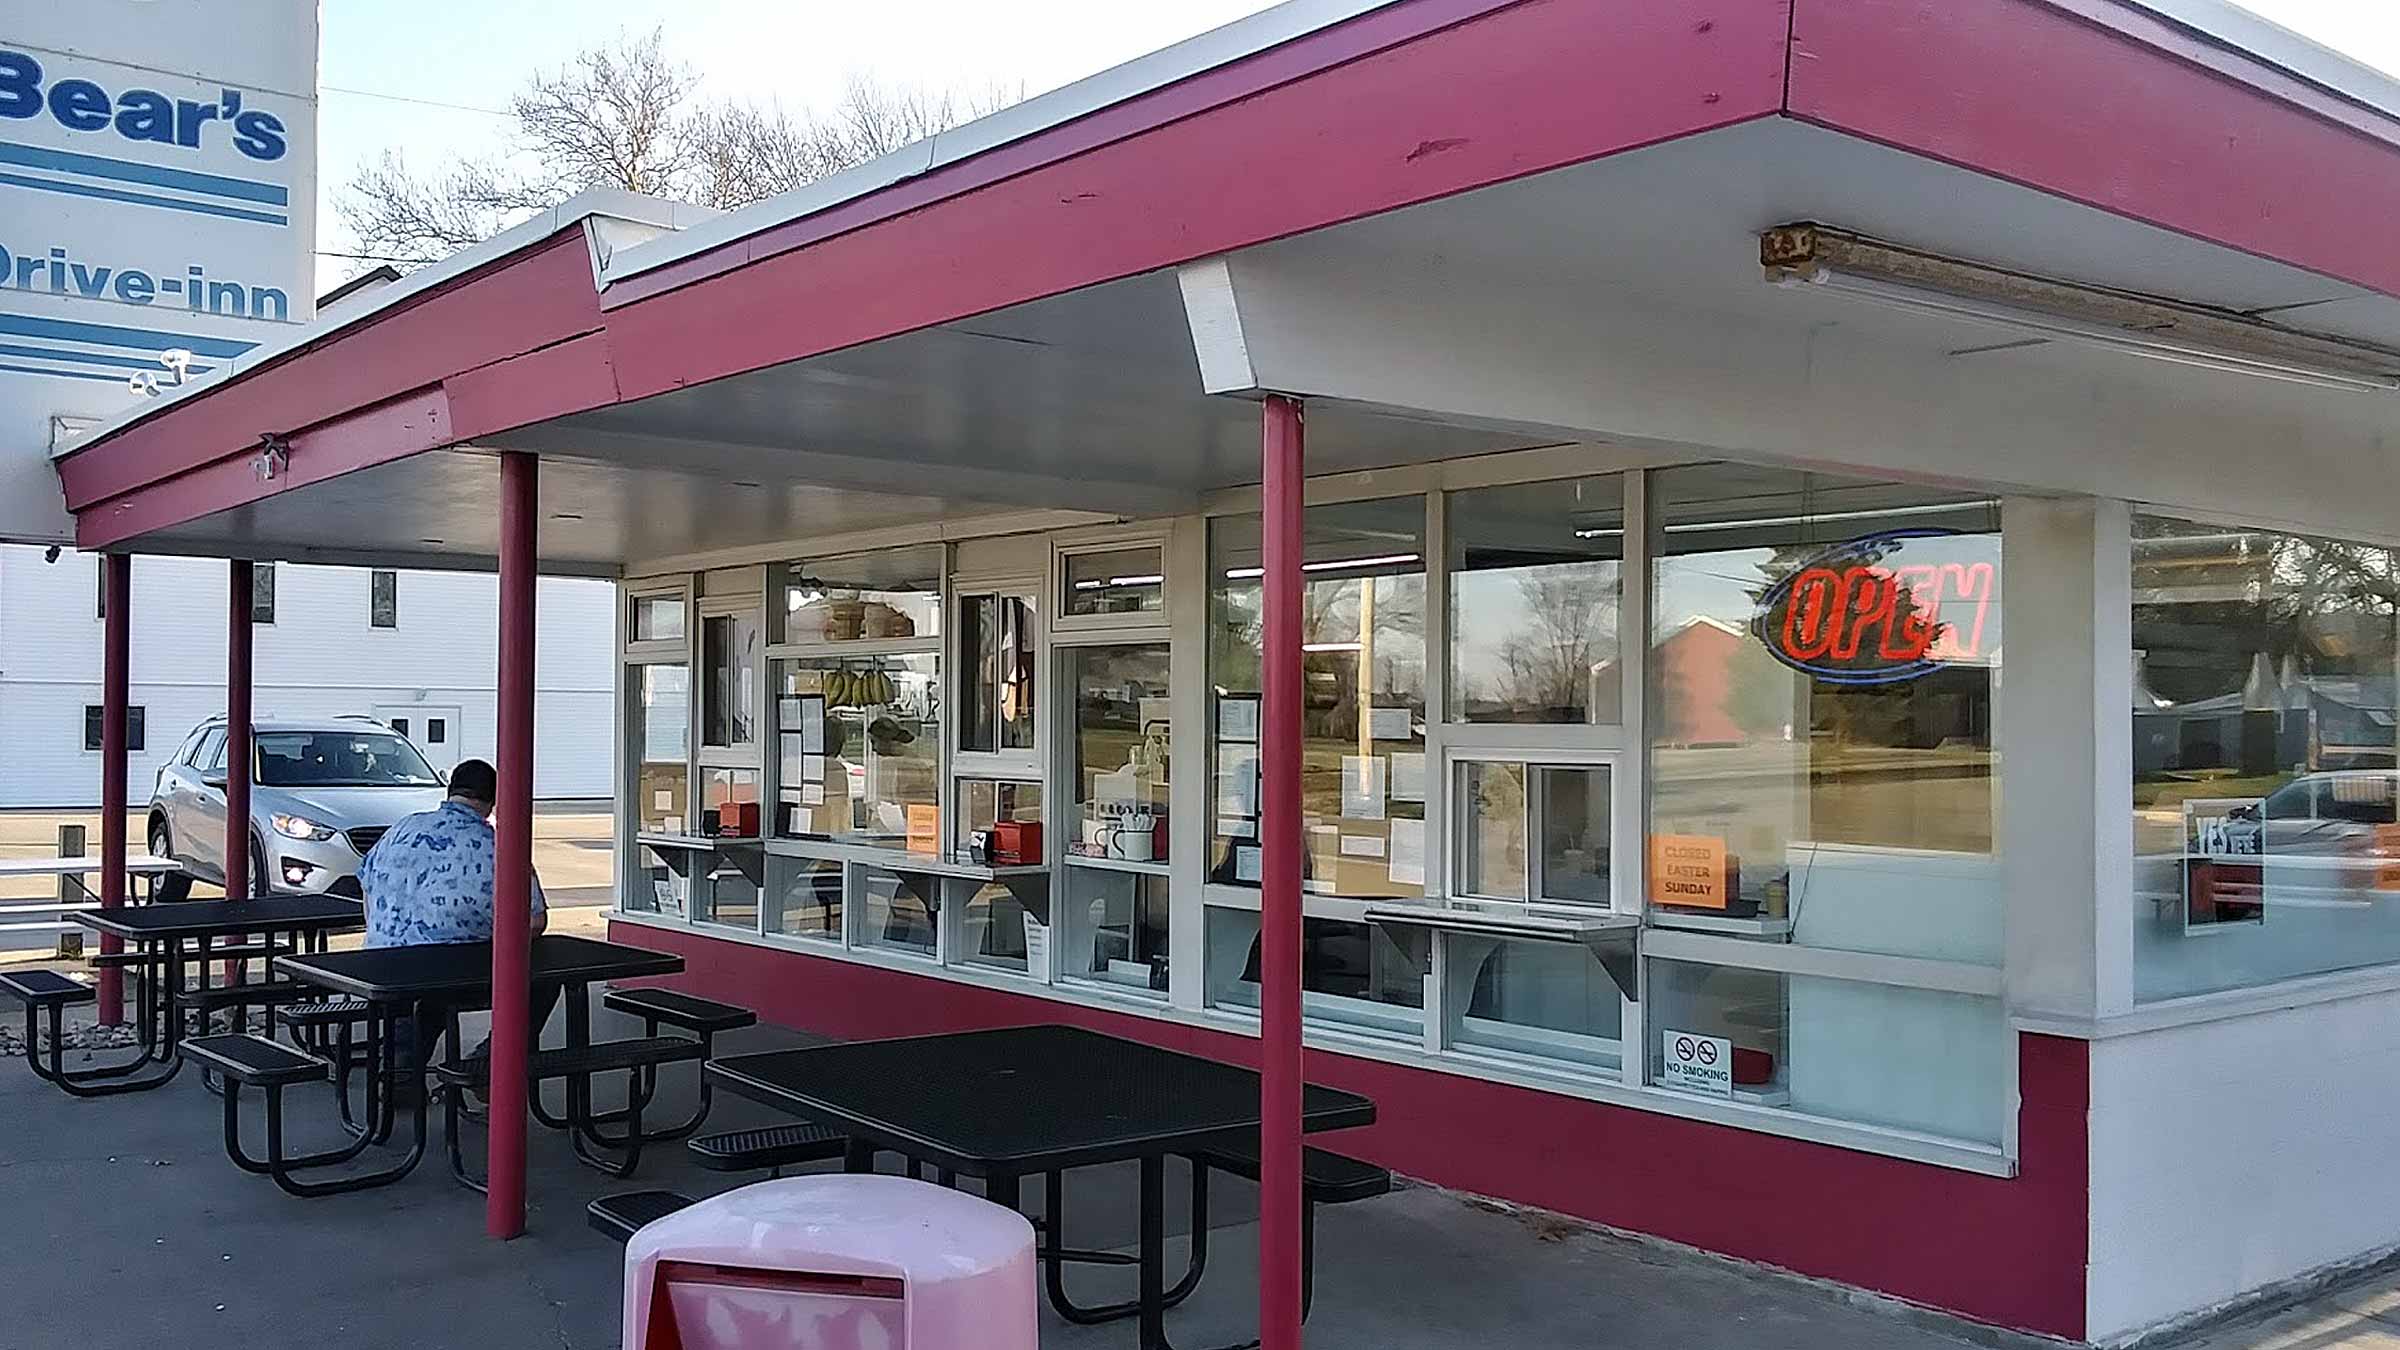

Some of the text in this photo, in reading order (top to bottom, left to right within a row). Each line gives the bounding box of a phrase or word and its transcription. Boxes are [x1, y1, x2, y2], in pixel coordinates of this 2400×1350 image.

[0, 50, 287, 161] Bear's
[0, 244, 288, 322] rive-inn
[1782, 562, 1994, 661] OPEN
[1664, 846, 1711, 860] CLOSED
[1667, 863, 1710, 878] EASTER
[1664, 881, 1712, 895] SUNDAY
[1666, 1061, 1680, 1073] NO
[1681, 1065, 1729, 1082] SMOKING
